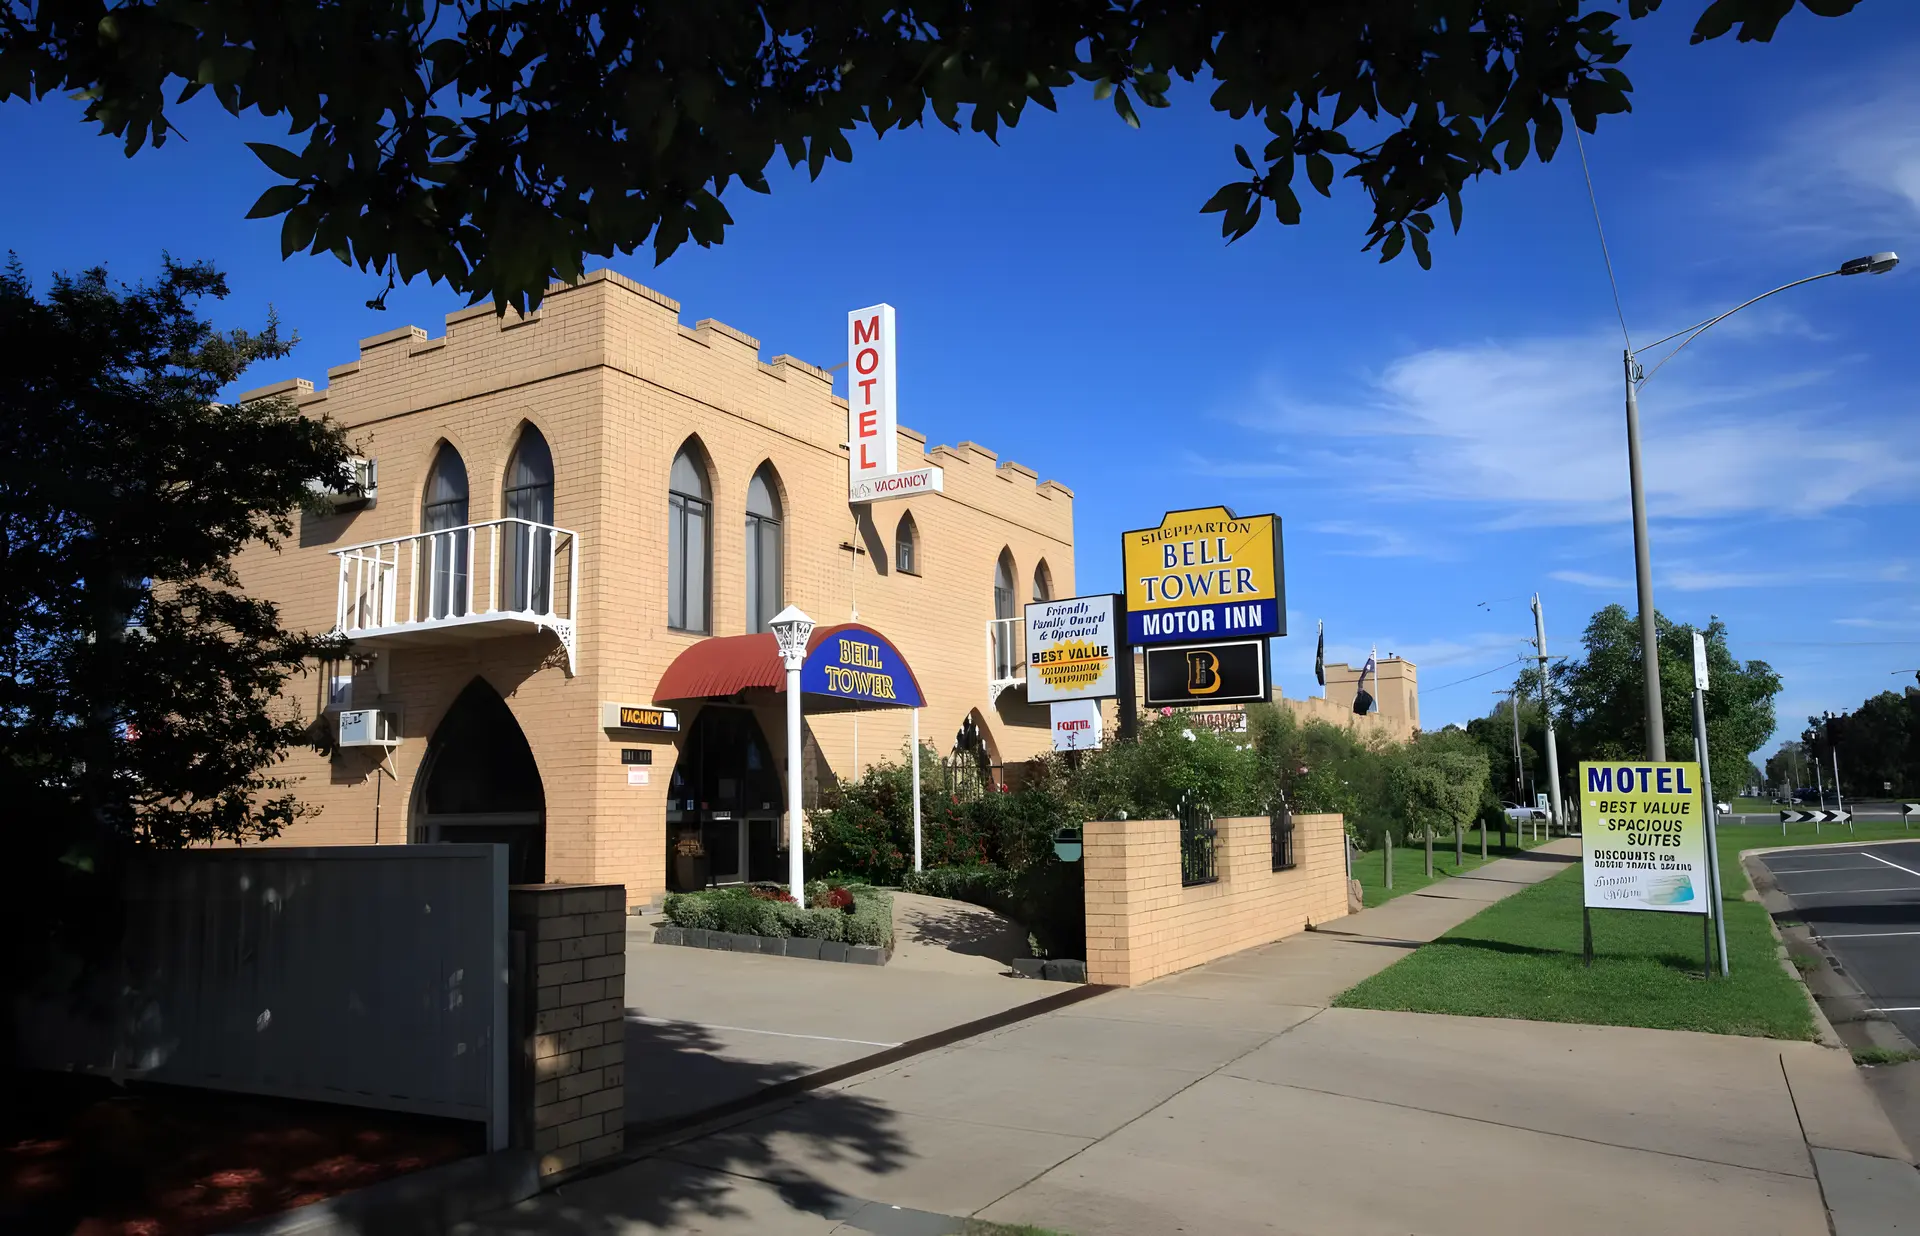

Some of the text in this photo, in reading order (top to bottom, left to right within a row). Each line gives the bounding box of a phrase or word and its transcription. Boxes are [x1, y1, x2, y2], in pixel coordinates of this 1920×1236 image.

[854, 315, 880, 469] MOTEL
[874, 473, 928, 492] VACANCY
[1141, 522, 1251, 546] SHEPPARTON
[1163, 537, 1232, 569] BELL
[1140, 567, 1259, 603] TOWER
[1046, 602, 1090, 617] Friendly
[1143, 604, 1263, 636] MOTOR INN
[838, 638, 883, 670] BELL
[1032, 645, 1109, 664] BEST VALUE
[824, 664, 897, 699] TOWER
[1186, 650, 1221, 694] B
[621, 708, 663, 726] VACANCY
[1587, 767, 1692, 794] MOTEL
[1599, 801, 1690, 814] BEST VALUE
[1608, 818, 1683, 832] SPACIOUS
[1627, 833, 1681, 847] SUITES
[1594, 850, 1655, 862] DISCOUNTS
